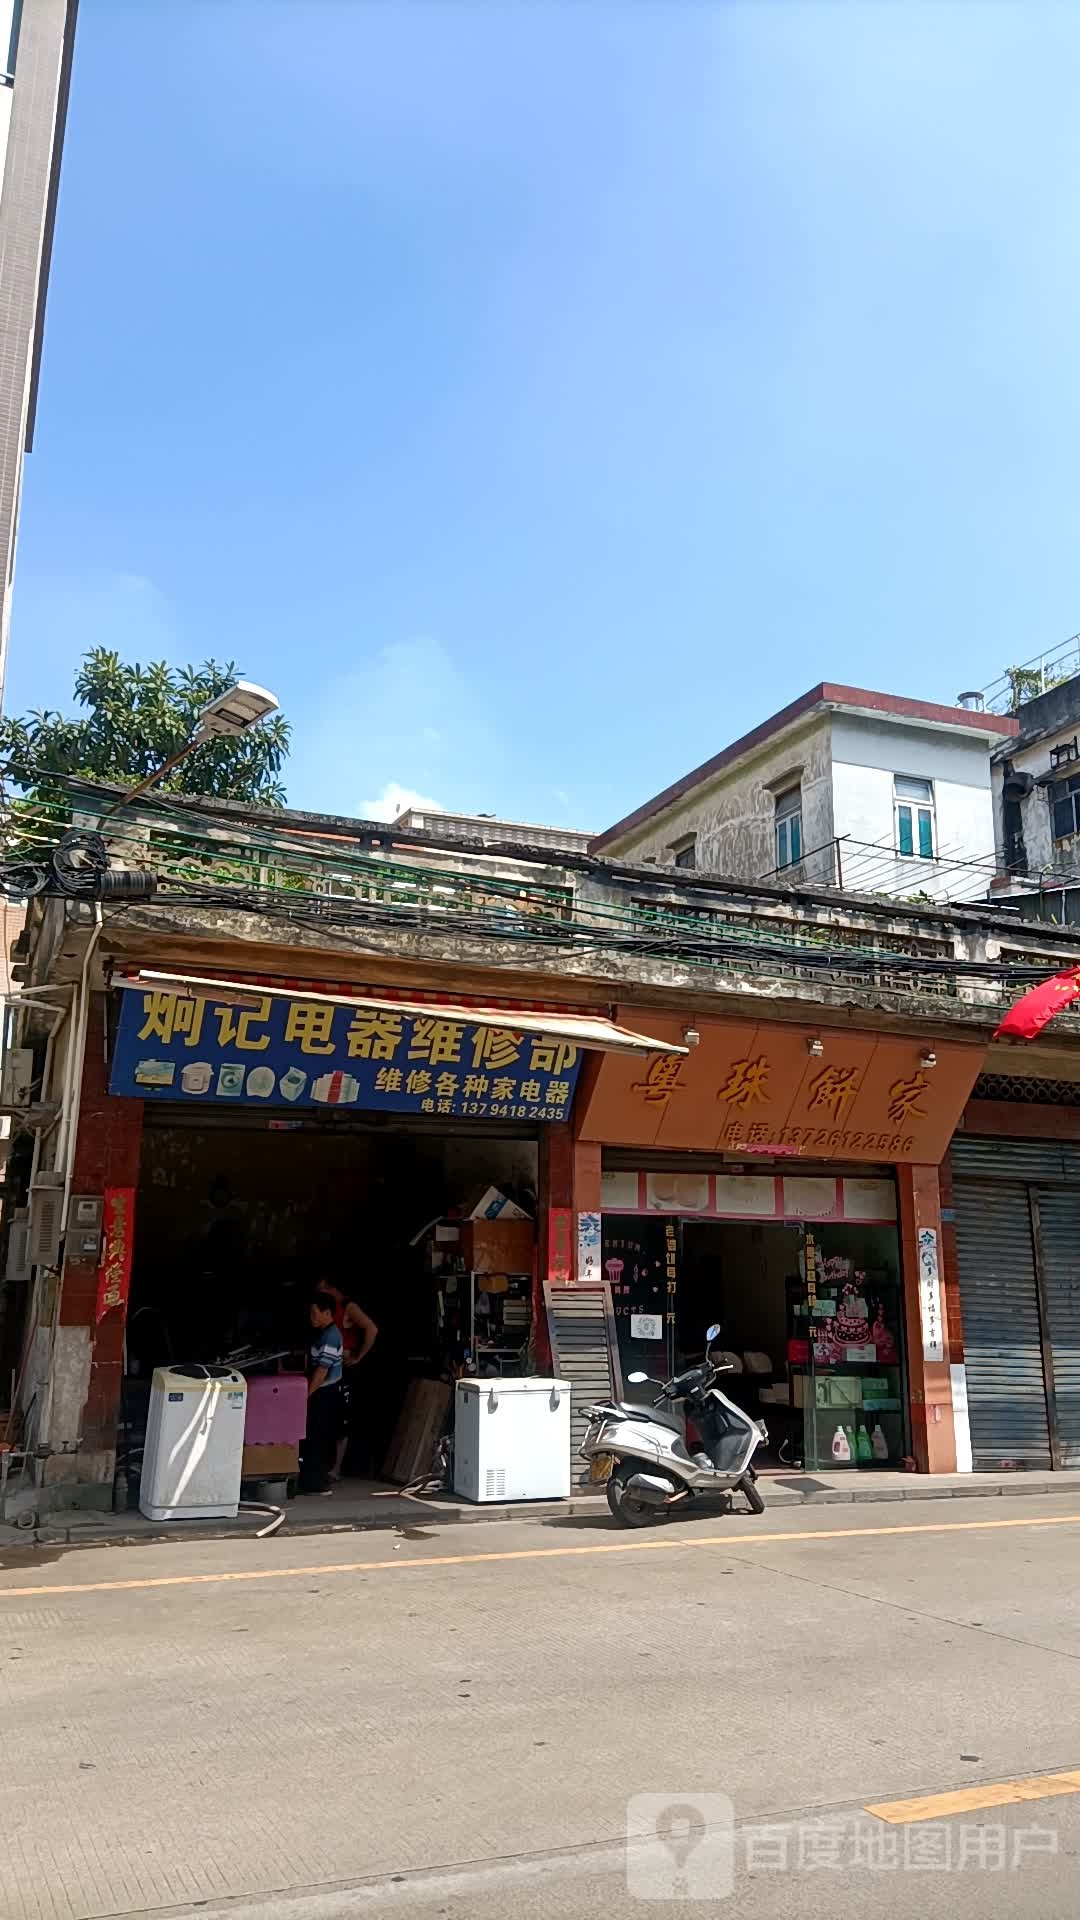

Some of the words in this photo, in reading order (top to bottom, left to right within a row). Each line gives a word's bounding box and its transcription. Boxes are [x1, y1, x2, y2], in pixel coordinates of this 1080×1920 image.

[374, 1066, 570, 1105] 维修各种家电器
[461, 1101, 486, 1116] 137
[490, 1103, 526, 1118] 9418
[530, 1106, 564, 1120] 2435
